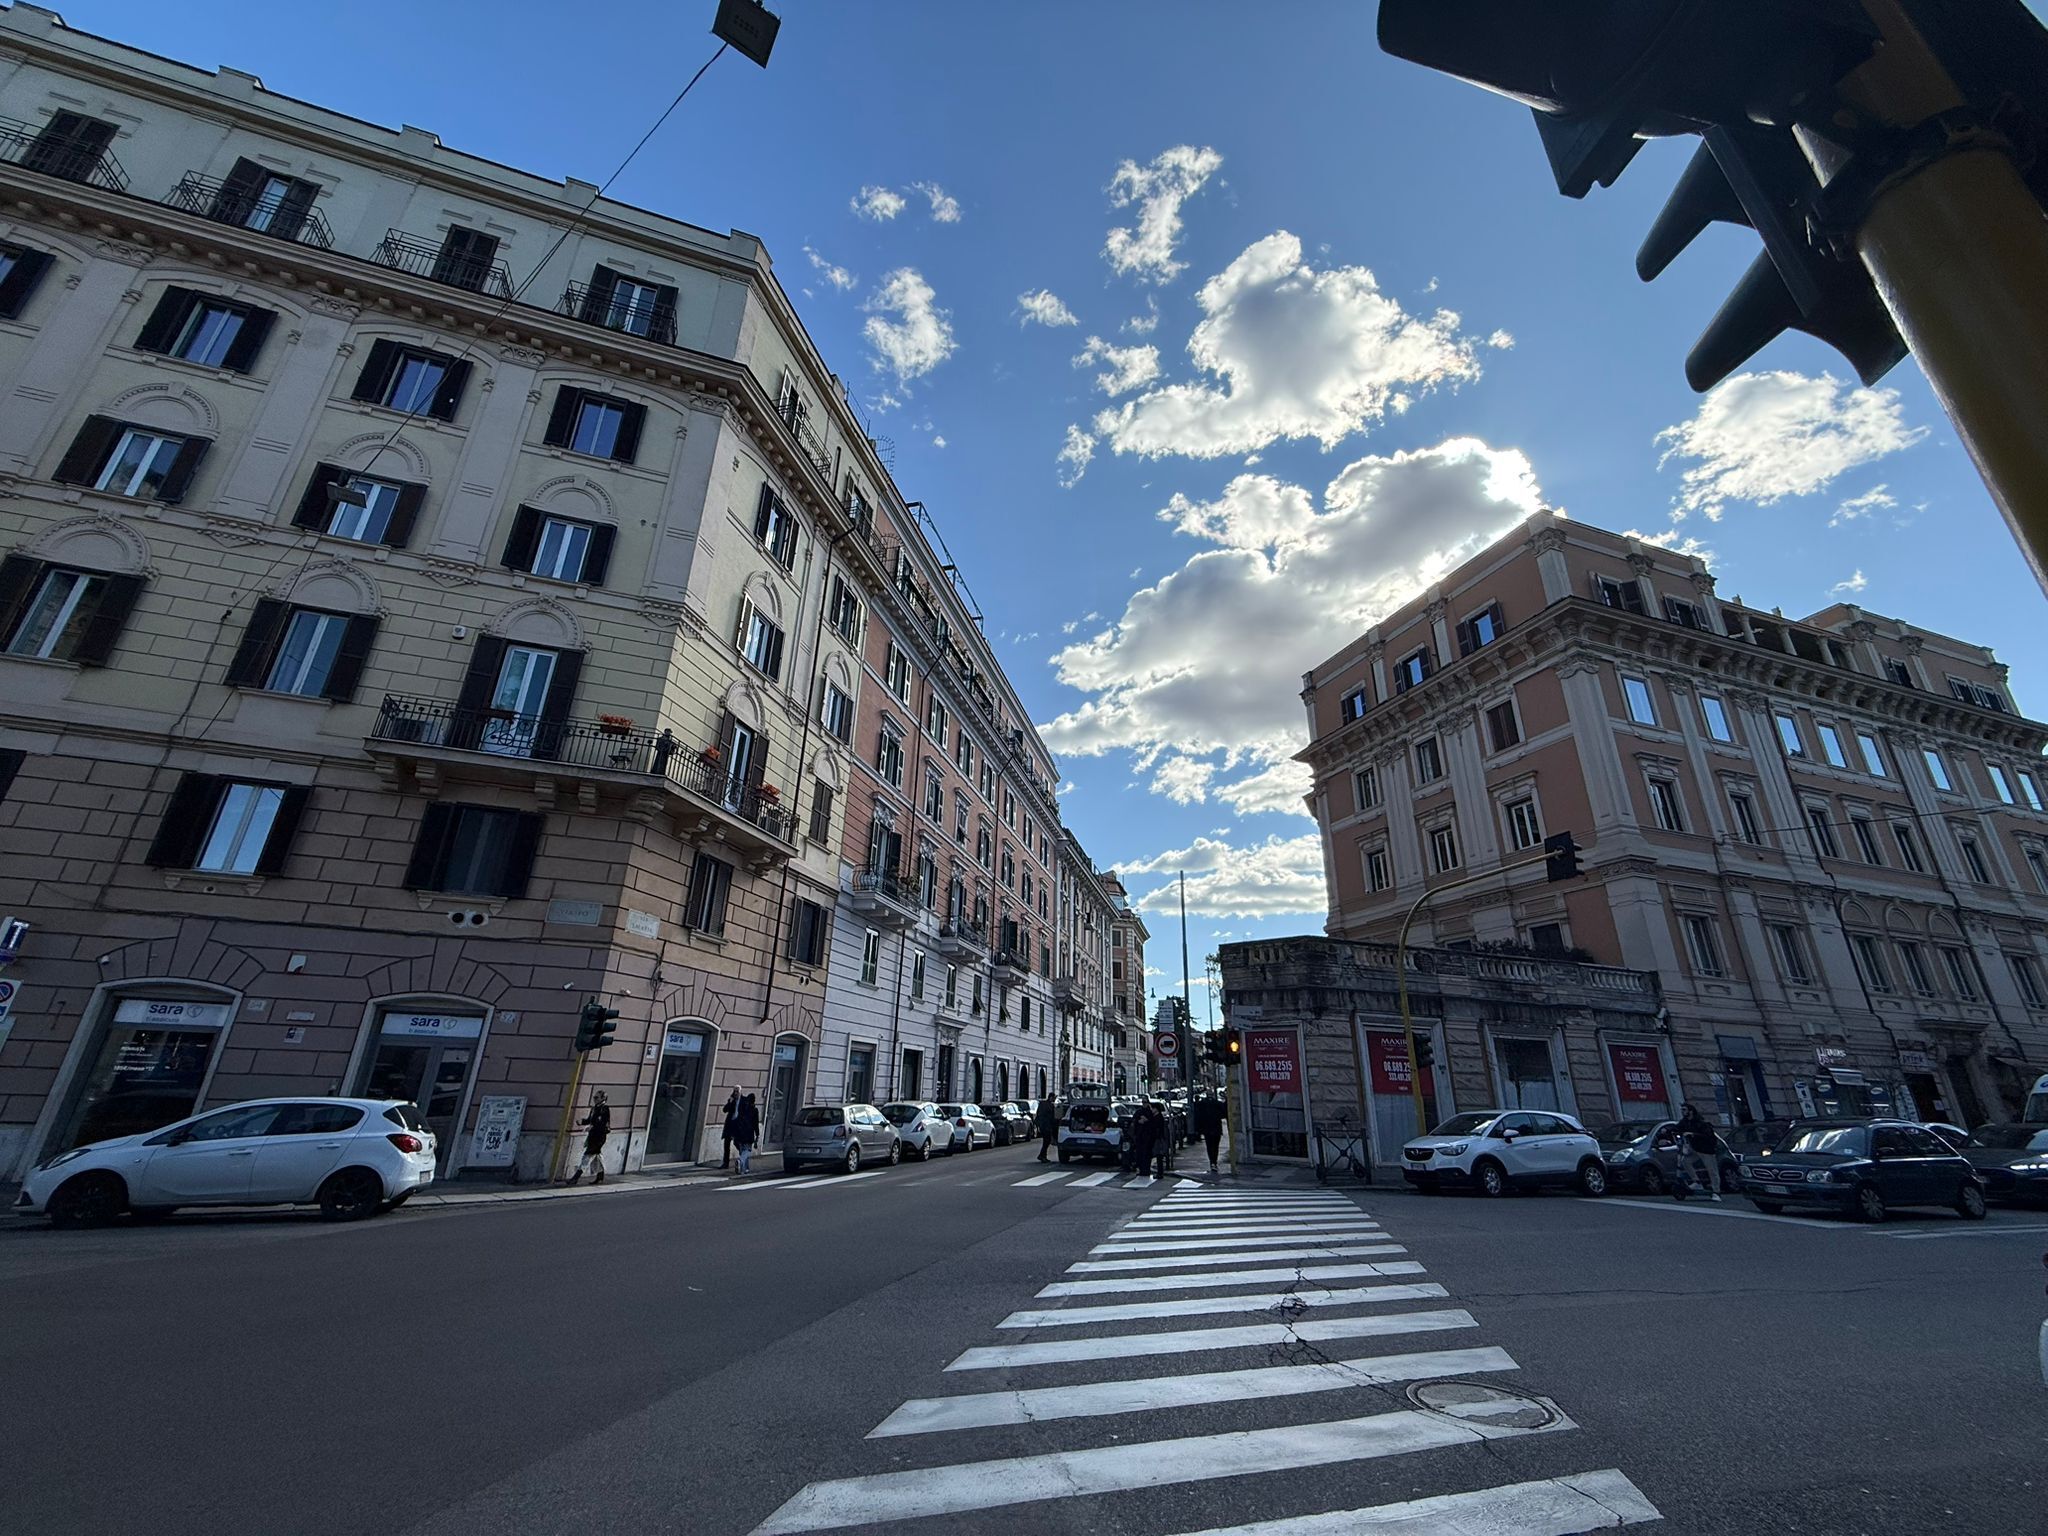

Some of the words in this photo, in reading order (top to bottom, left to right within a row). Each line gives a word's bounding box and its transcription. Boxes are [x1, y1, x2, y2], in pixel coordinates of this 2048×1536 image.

[149, 1004, 183, 1014] sara
[410, 1017, 440, 1027] sara
[670, 1034, 684, 1043] sara
[1255, 1060, 1292, 1071] 06.689.2515
